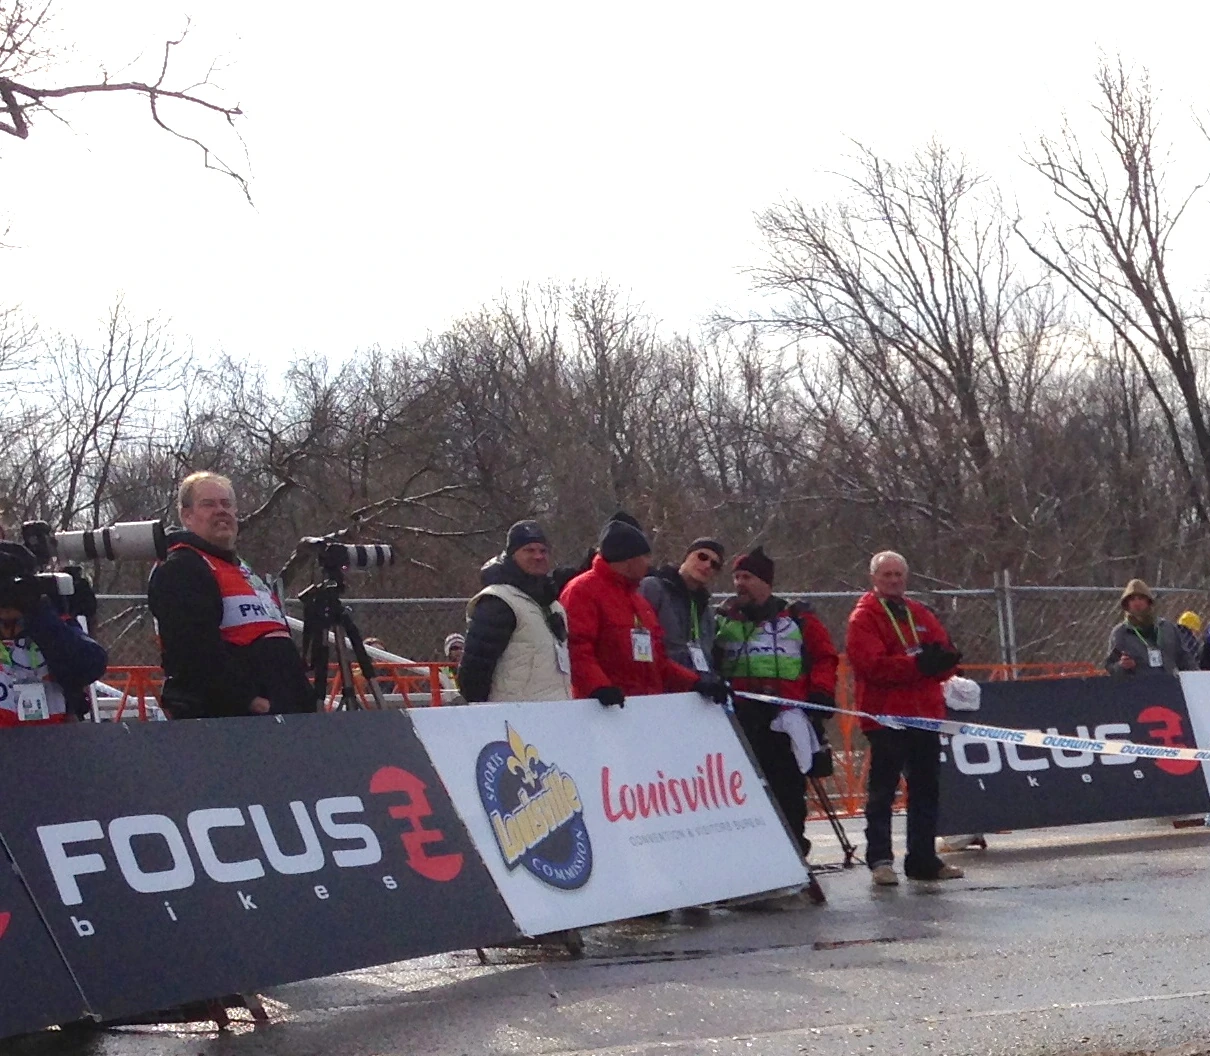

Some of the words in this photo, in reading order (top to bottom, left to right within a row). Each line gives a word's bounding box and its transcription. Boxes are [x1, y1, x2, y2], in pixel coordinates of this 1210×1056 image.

[940, 723, 1139, 776] OCUS
[1042, 735, 1107, 752] SHIMANO
[485, 751, 505, 803] SPORTS
[601, 752, 747, 823] Louisville
[490, 762, 584, 867] Louisville
[37, 795, 383, 907] FOCUS
[531, 827, 588, 882] COMMISSION
[70, 874, 399, 938] bikes
